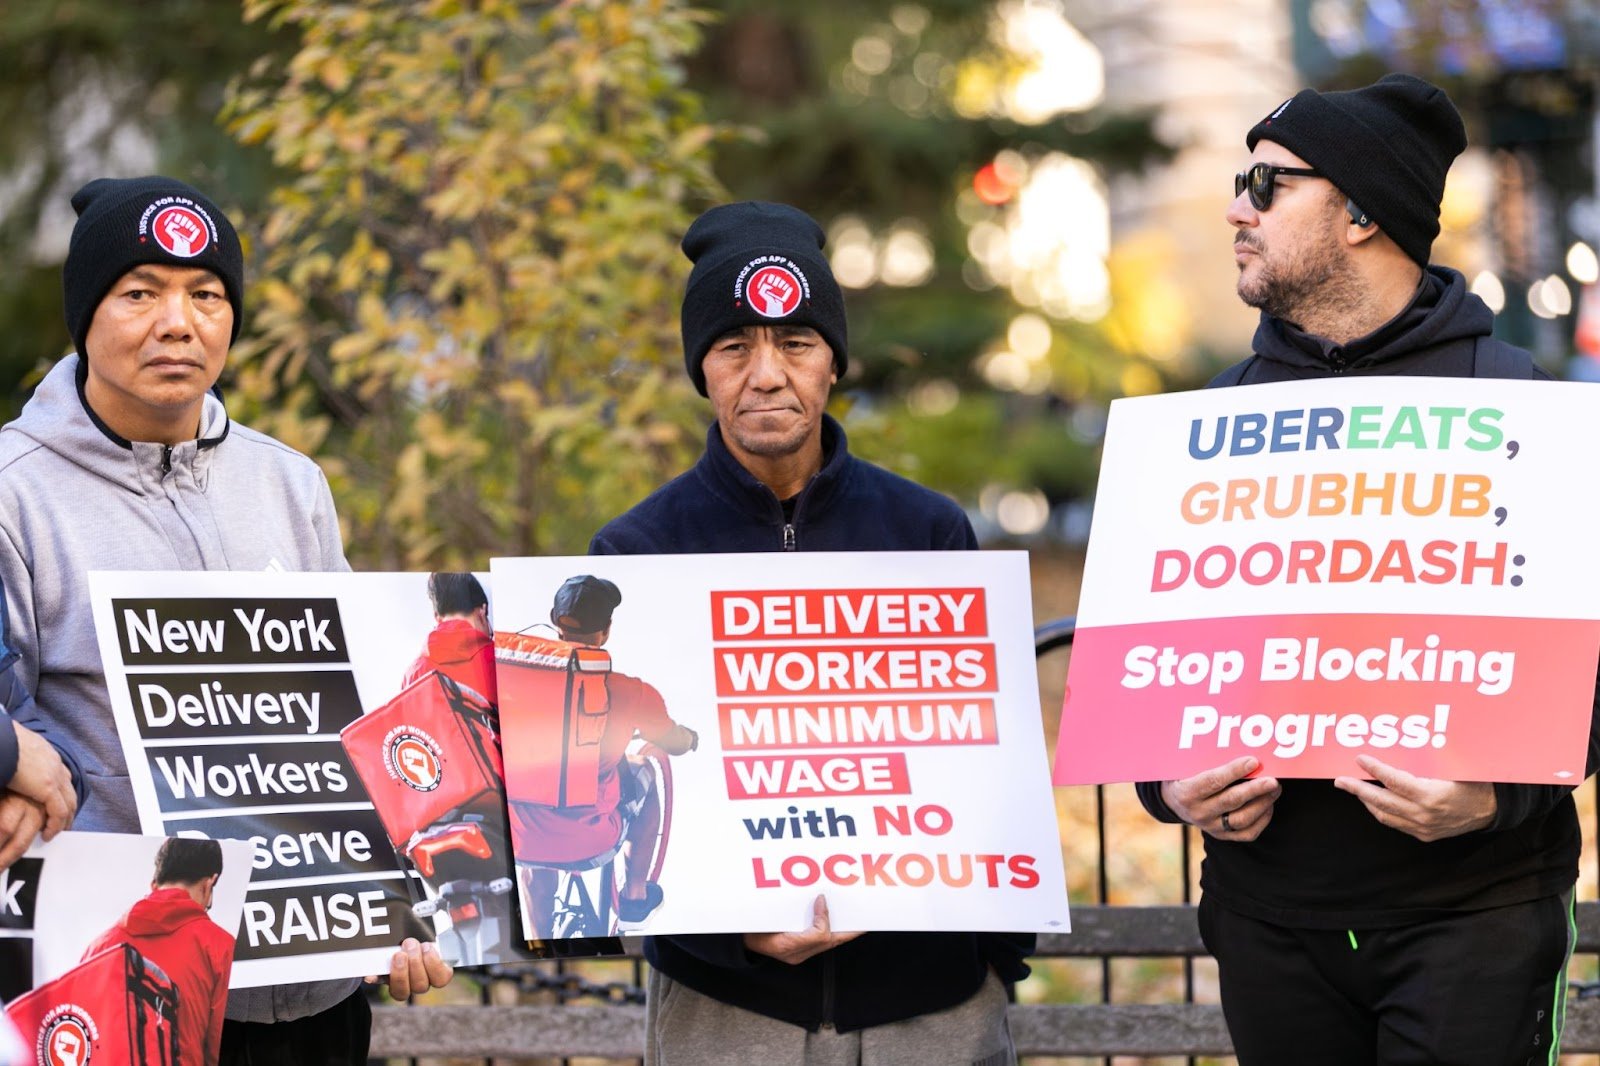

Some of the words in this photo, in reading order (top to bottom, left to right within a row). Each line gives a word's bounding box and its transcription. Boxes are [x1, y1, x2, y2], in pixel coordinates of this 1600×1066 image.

[139, 203, 158, 235] JUSTICE
[155, 196, 174, 207] FOR
[175, 196, 194, 206] APP
[194, 203, 219, 243] WORKERS
[734, 265, 752, 299] JUSTICE
[749, 255, 768, 268] FOR
[768, 254, 787, 264] APP
[786, 260, 811, 299] WORKERS
[1187, 405, 1520, 461] UBEREATS,
[1180, 471, 1508, 528] GRUBHUB,
[1150, 539, 1526, 593] DOORDASH:
[122, 608, 225, 654] New
[233, 607, 337, 653] York
[722, 593, 976, 636] DELIVERY
[722, 648, 987, 692] WORKERS
[1120, 645, 1245, 695] Stop
[1259, 634, 1516, 697] Blocking
[137, 680, 321, 735] Delivery
[729, 703, 983, 746] MINIMUM
[1178, 704, 1451, 759] Progress!
[154, 753, 348, 801] Workers
[732, 757, 894, 795] WAGE
[742, 805, 857, 841] with
[872, 803, 954, 837] NO
[751, 852, 1041, 890] LOCKOUTS
[243, 889, 391, 948] RAISE
